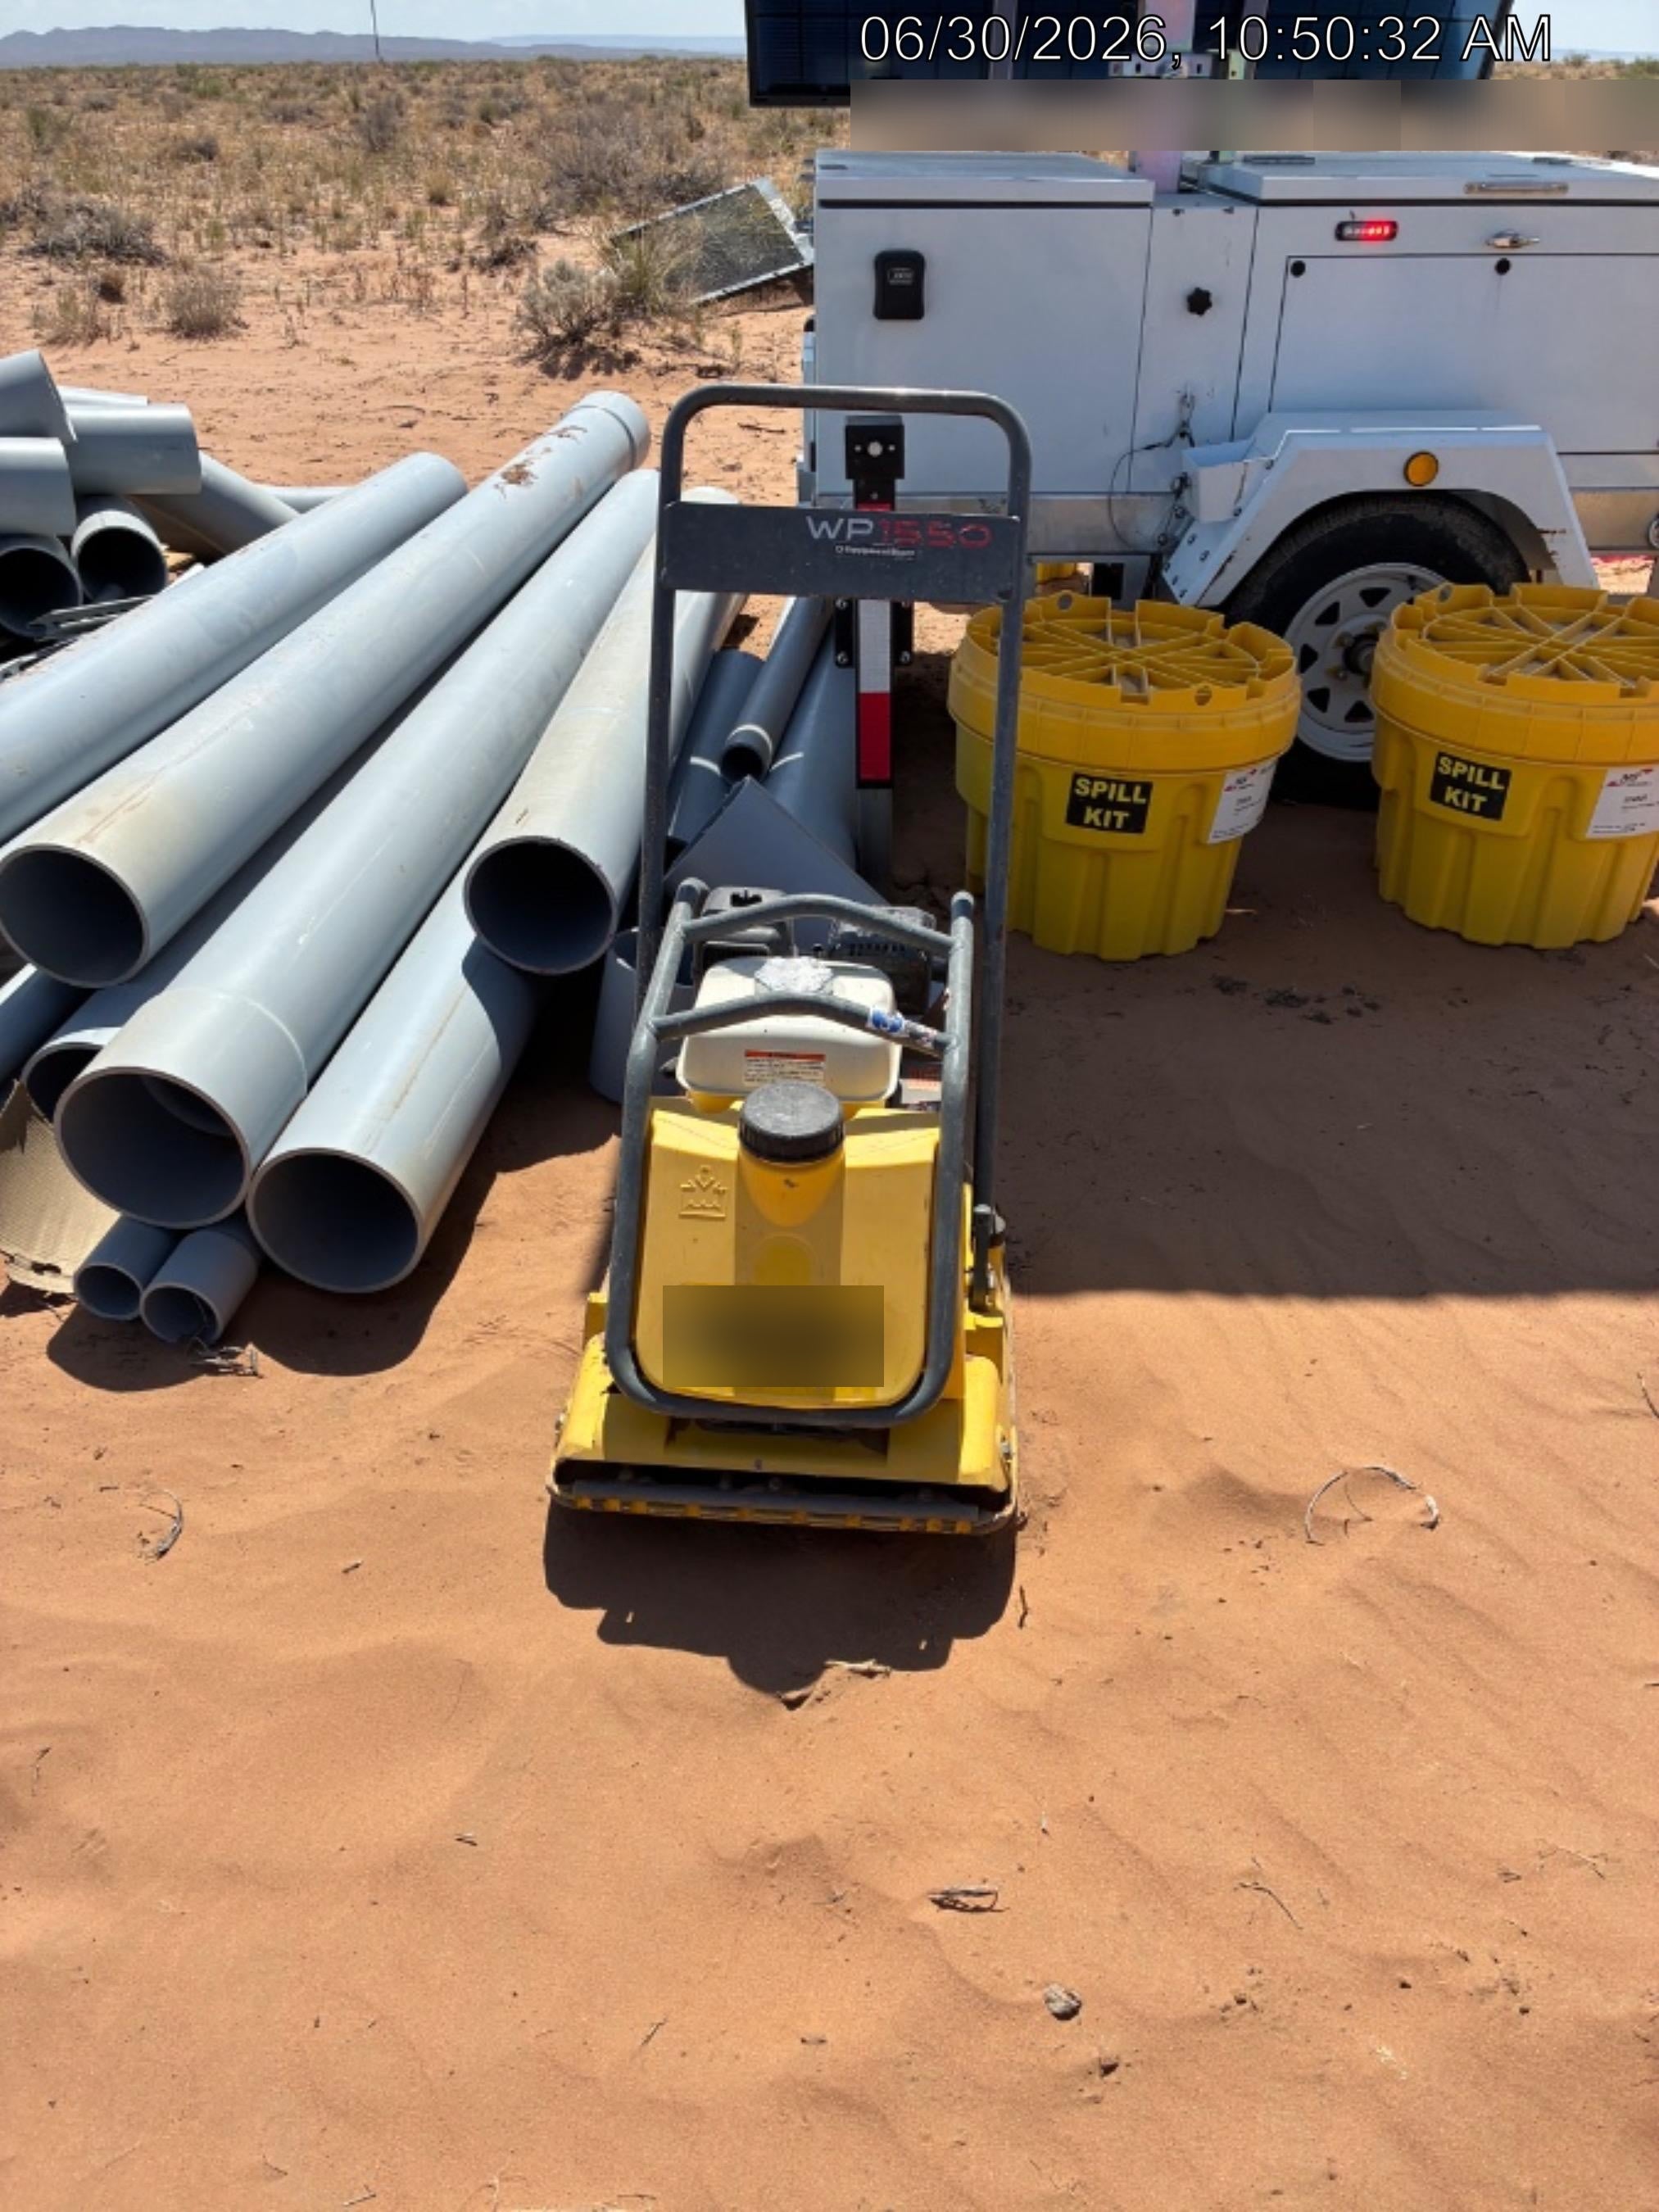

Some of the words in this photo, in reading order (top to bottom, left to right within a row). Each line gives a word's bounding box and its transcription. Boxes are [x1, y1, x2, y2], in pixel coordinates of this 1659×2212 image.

[805, 515, 994, 550] WP1550
[1438, 756, 1505, 790] SPILL
[1074, 777, 1147, 804] SPILL
[1444, 786, 1488, 812] KIT
[1083, 805, 1130, 829] KIT
